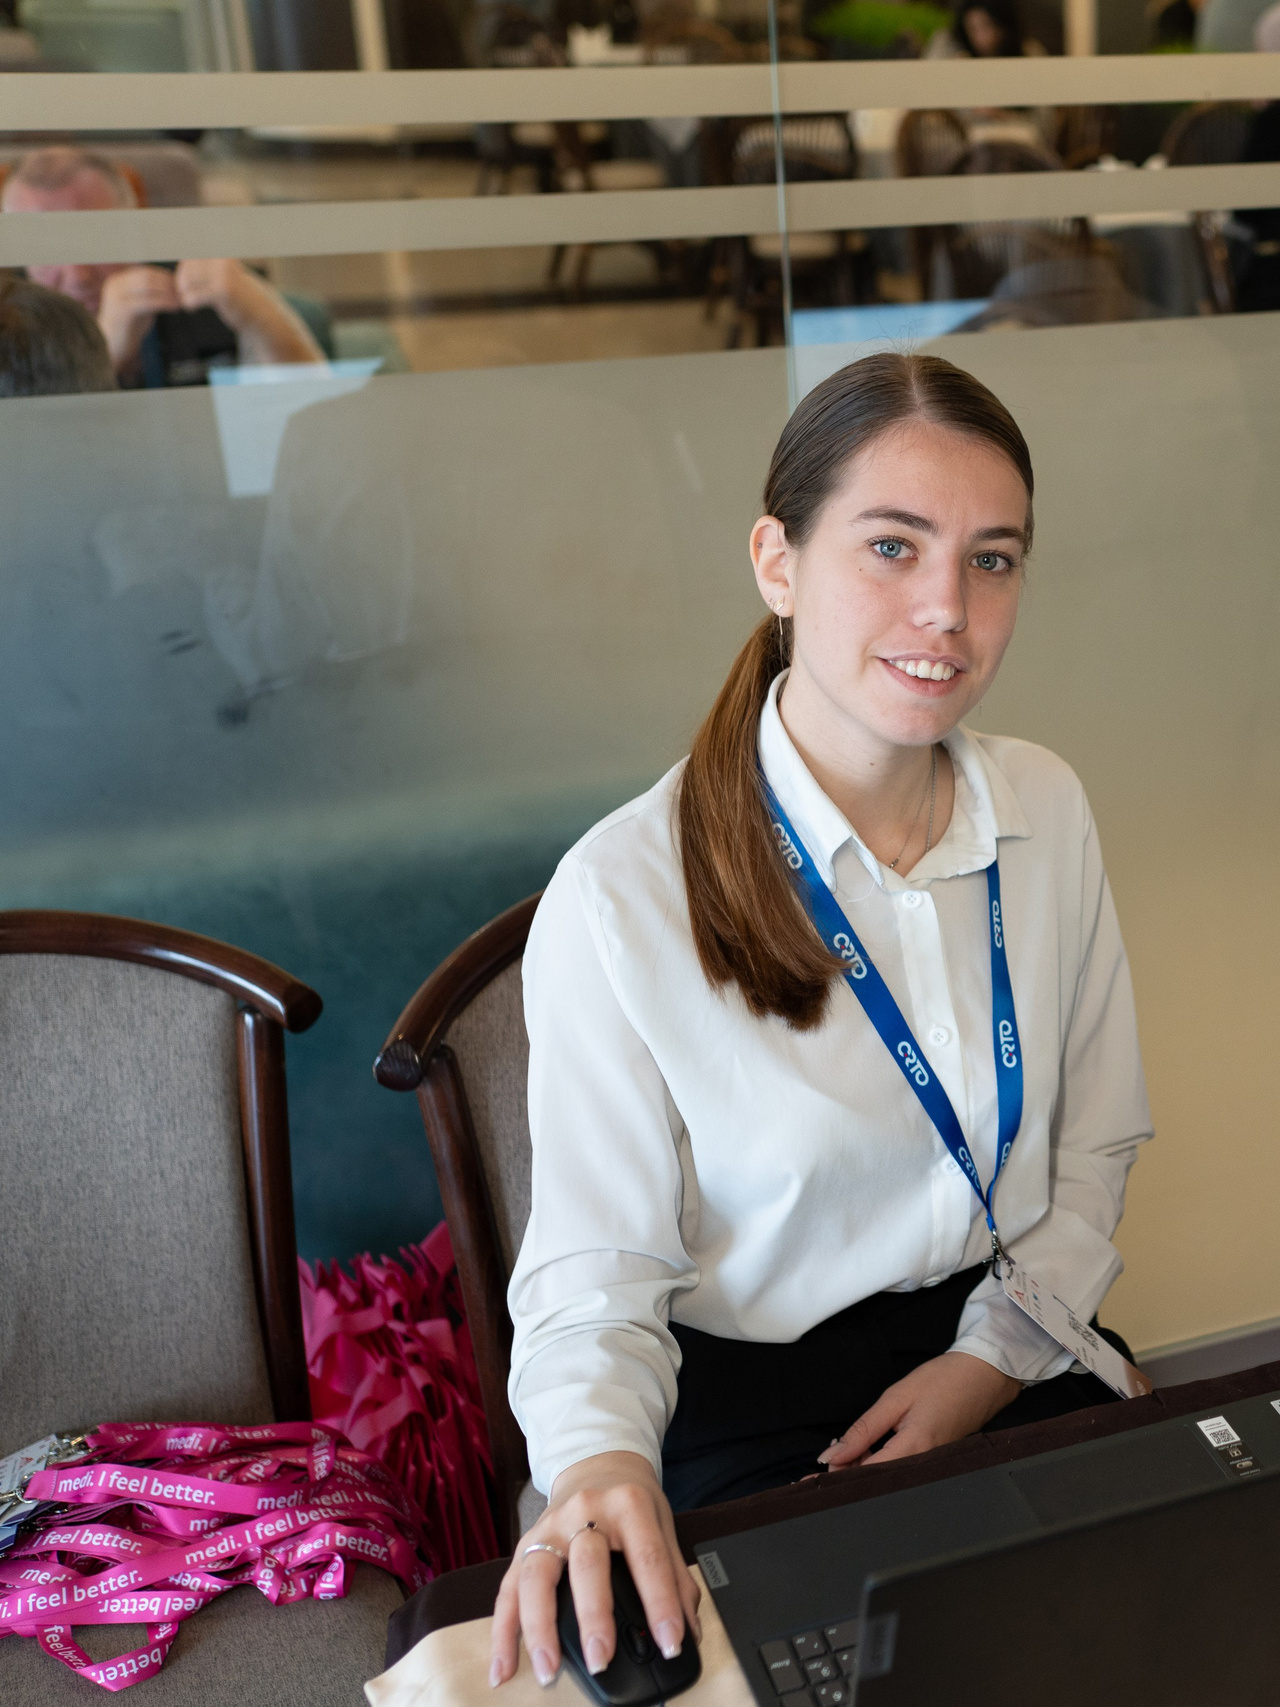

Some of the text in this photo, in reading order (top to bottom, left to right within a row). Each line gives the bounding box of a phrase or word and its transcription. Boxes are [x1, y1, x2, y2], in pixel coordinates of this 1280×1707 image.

[166, 1432, 204, 1451] medi.
[58, 1470, 216, 1505] medi. I feel better.
[42, 1530, 80, 1546] feel
[80, 1528, 143, 1555] better.
[184, 1507, 349, 1565] medi. I feel bette
[296, 1533, 330, 1558] feel
[334, 1531, 390, 1562] better.
[17, 1569, 143, 1614] I feel better.
[255, 1556, 279, 1596] bett
[98, 1597, 161, 1615] better.
[91, 1647, 163, 1684] better.
